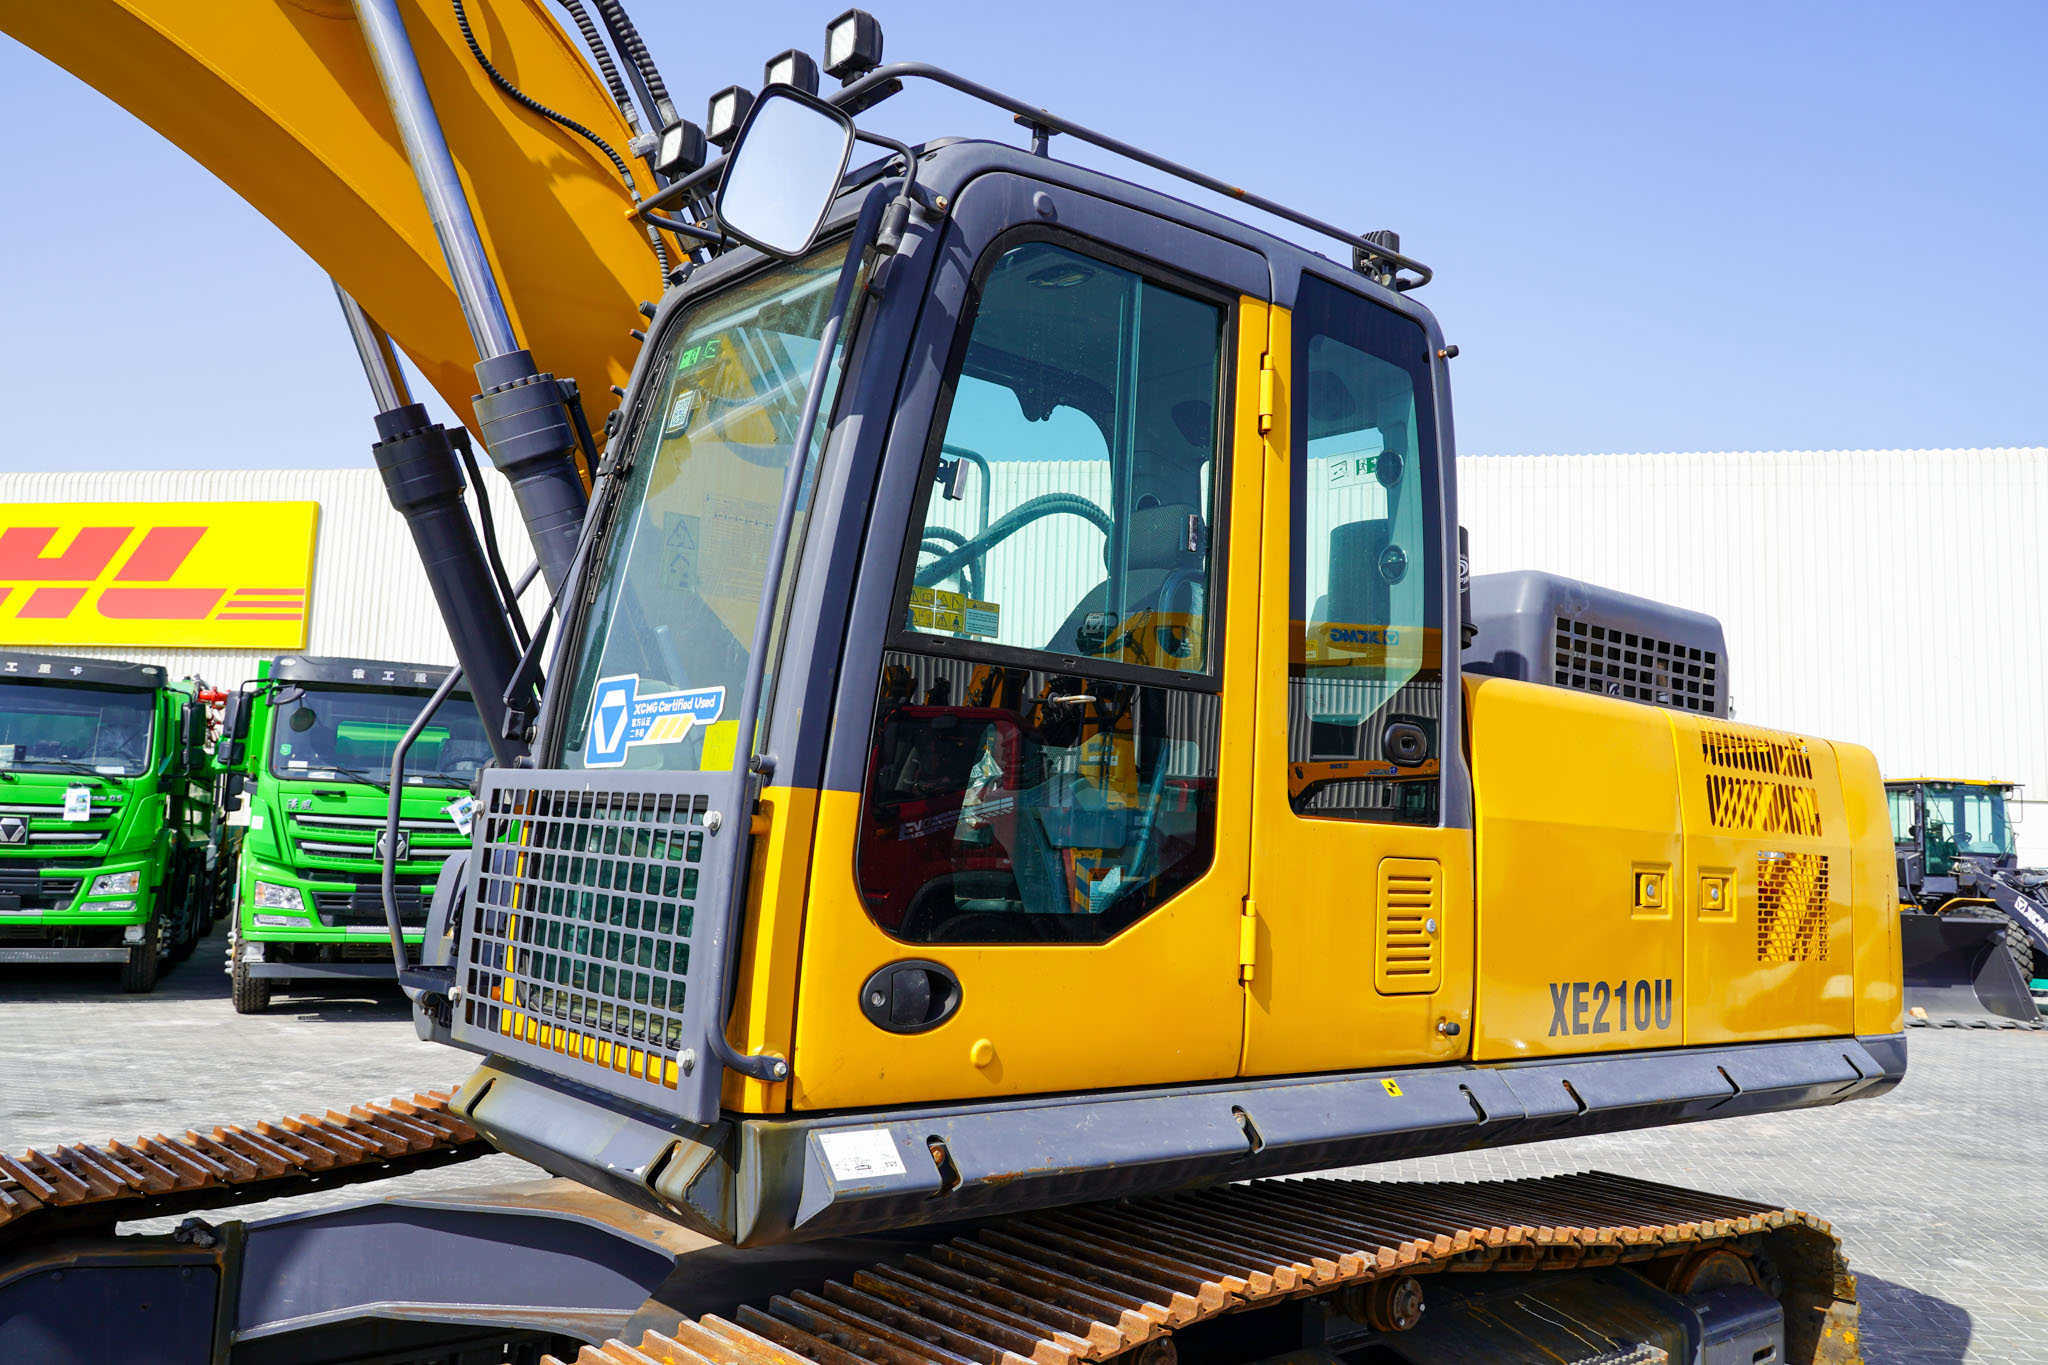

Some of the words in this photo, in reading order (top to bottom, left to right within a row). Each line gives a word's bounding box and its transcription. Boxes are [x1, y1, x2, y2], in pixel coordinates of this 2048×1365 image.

[634, 702, 657, 715] XCMG
[659, 698, 693, 713] Certified
[695, 695, 716, 708] Used
[1548, 978, 1673, 1037] XE210U
